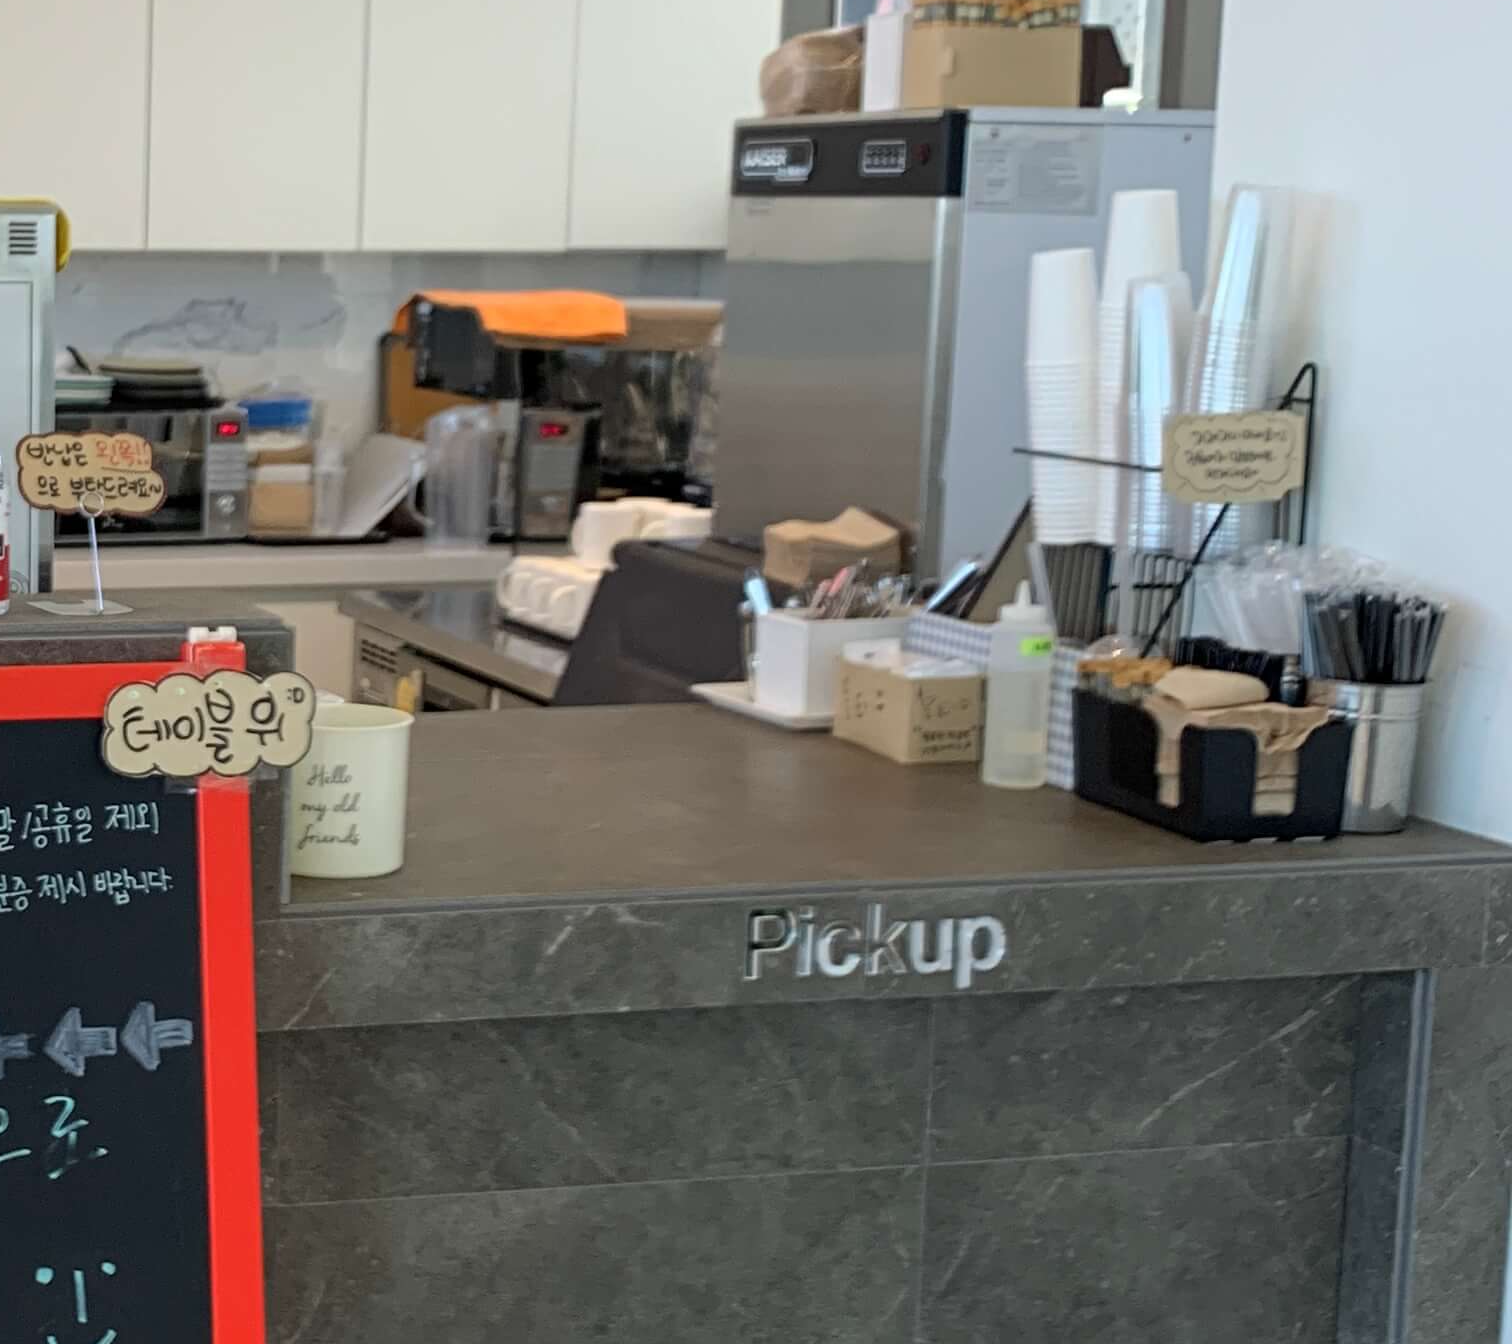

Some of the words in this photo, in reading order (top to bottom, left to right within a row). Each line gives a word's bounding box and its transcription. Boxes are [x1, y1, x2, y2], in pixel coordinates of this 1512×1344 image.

[38, 476, 61, 497] 으로
[306, 763, 353, 788] Hello
[104, 802, 160, 834] 제외
[300, 803, 327, 822] my
[38, 870, 87, 905] 제시
[742, 902, 1008, 988] Pickup
